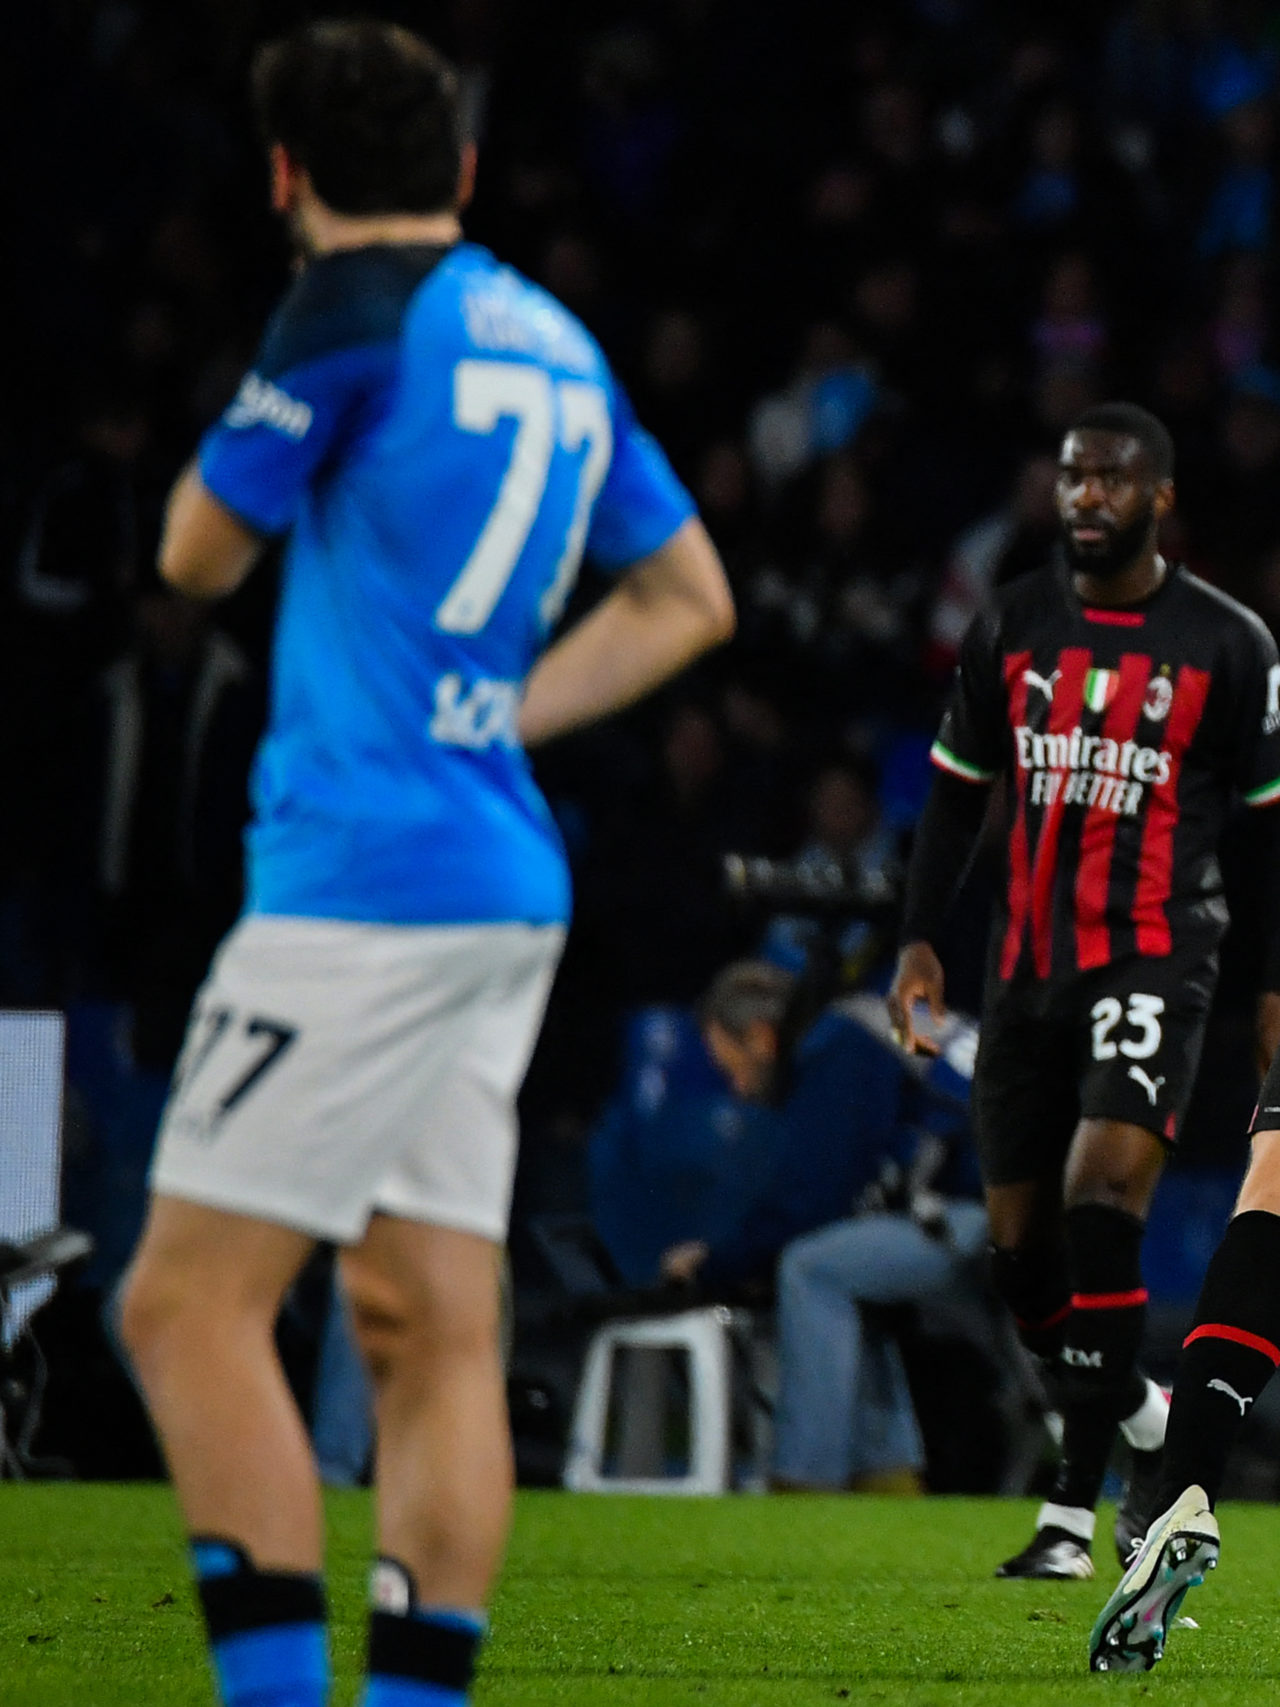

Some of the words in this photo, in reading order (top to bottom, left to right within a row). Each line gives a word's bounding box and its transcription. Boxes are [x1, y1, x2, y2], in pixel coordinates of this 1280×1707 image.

[433, 359, 614, 636] 77
[1014, 726, 1173, 784] Emirates
[1091, 992, 1165, 1061] 23
